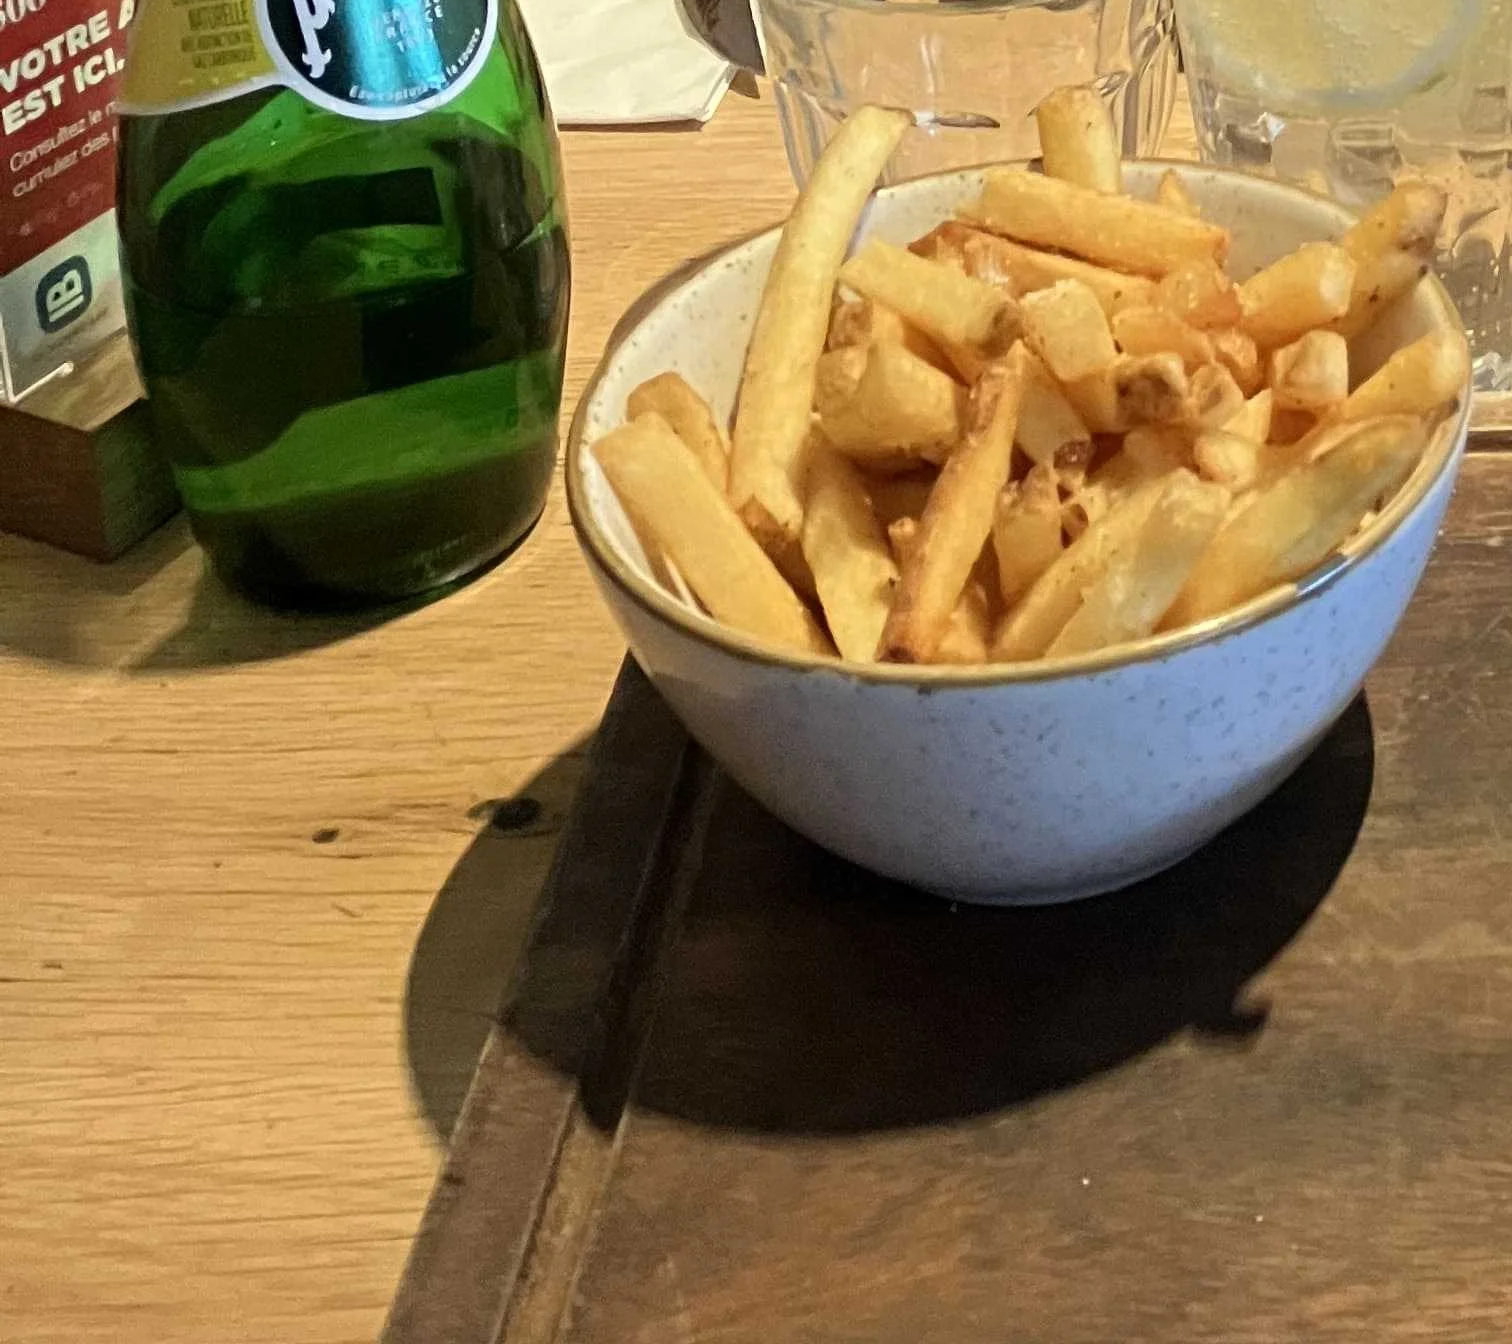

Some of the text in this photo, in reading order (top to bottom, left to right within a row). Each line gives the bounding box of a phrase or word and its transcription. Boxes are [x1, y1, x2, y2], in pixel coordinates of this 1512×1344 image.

[0, 10, 111, 93] VOTRE
[2, 74, 66, 136] EST
[9, 117, 86, 173] Consultez
